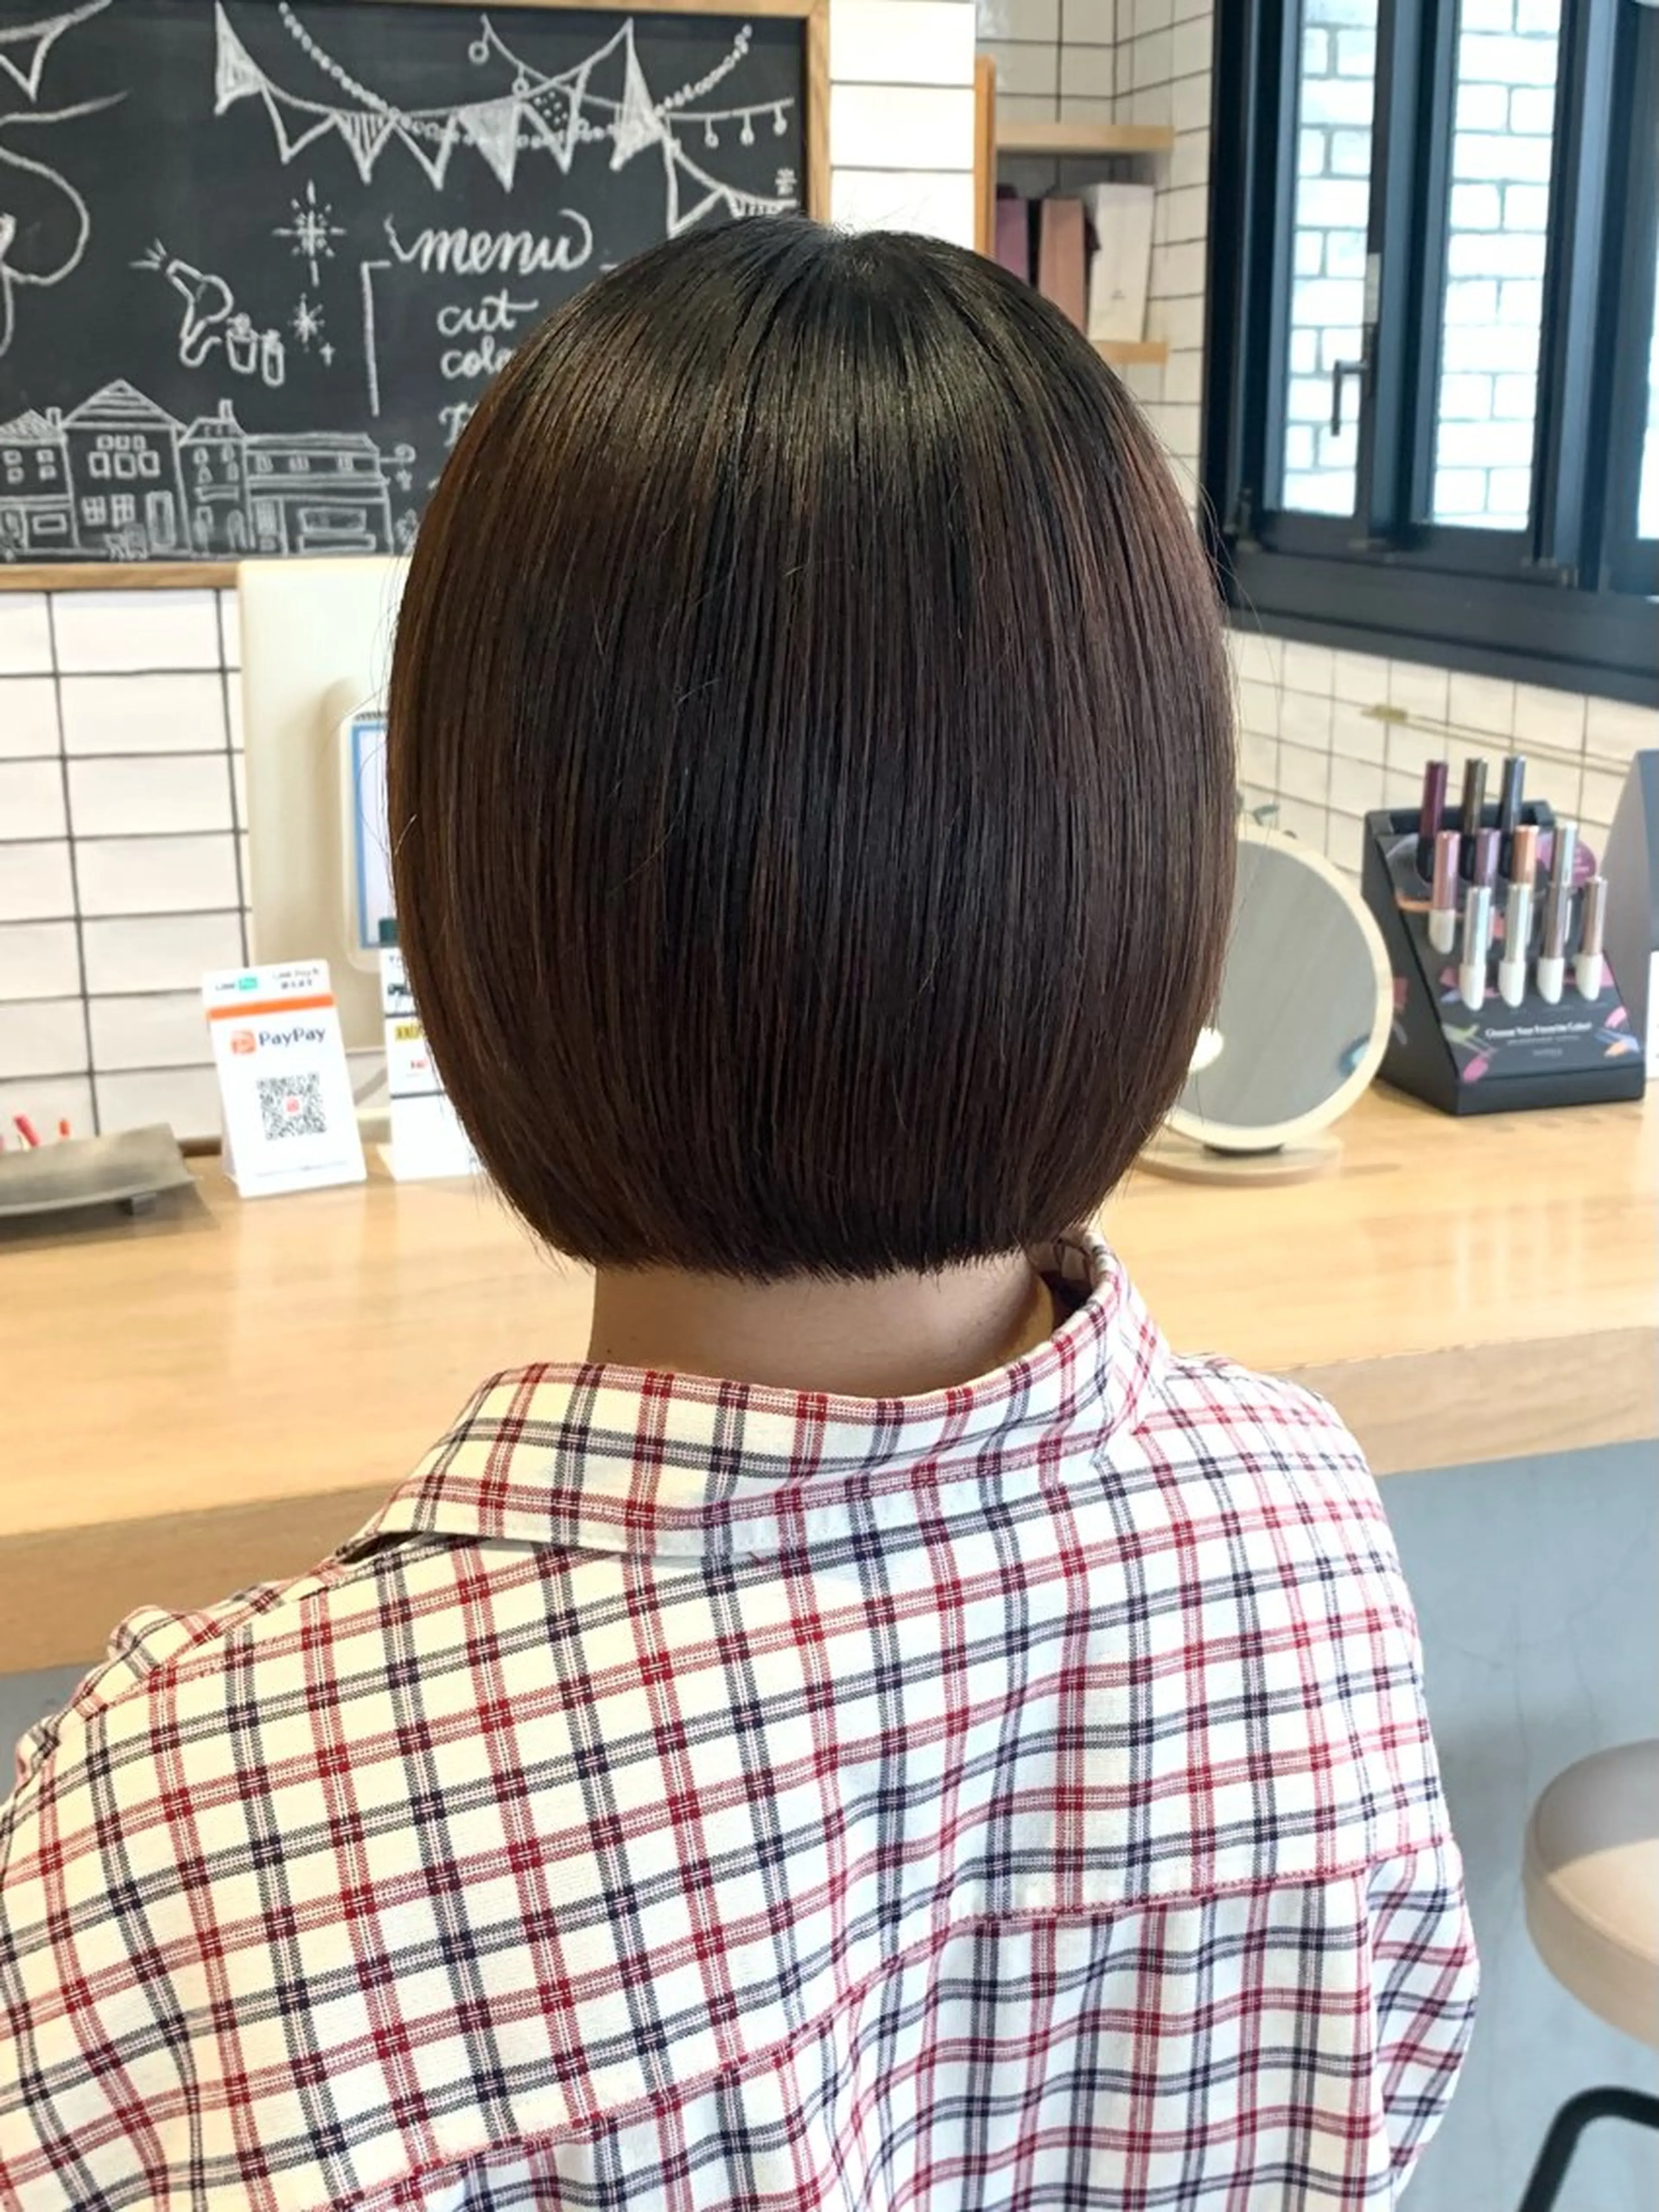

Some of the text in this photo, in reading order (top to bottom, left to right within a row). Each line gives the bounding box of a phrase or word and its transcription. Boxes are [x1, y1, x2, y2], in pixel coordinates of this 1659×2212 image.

[384, 209, 592, 275] menu
[437, 288, 539, 336] cut
[441, 335, 516, 379] colo
[259, 1027, 326, 1048] PayPay
